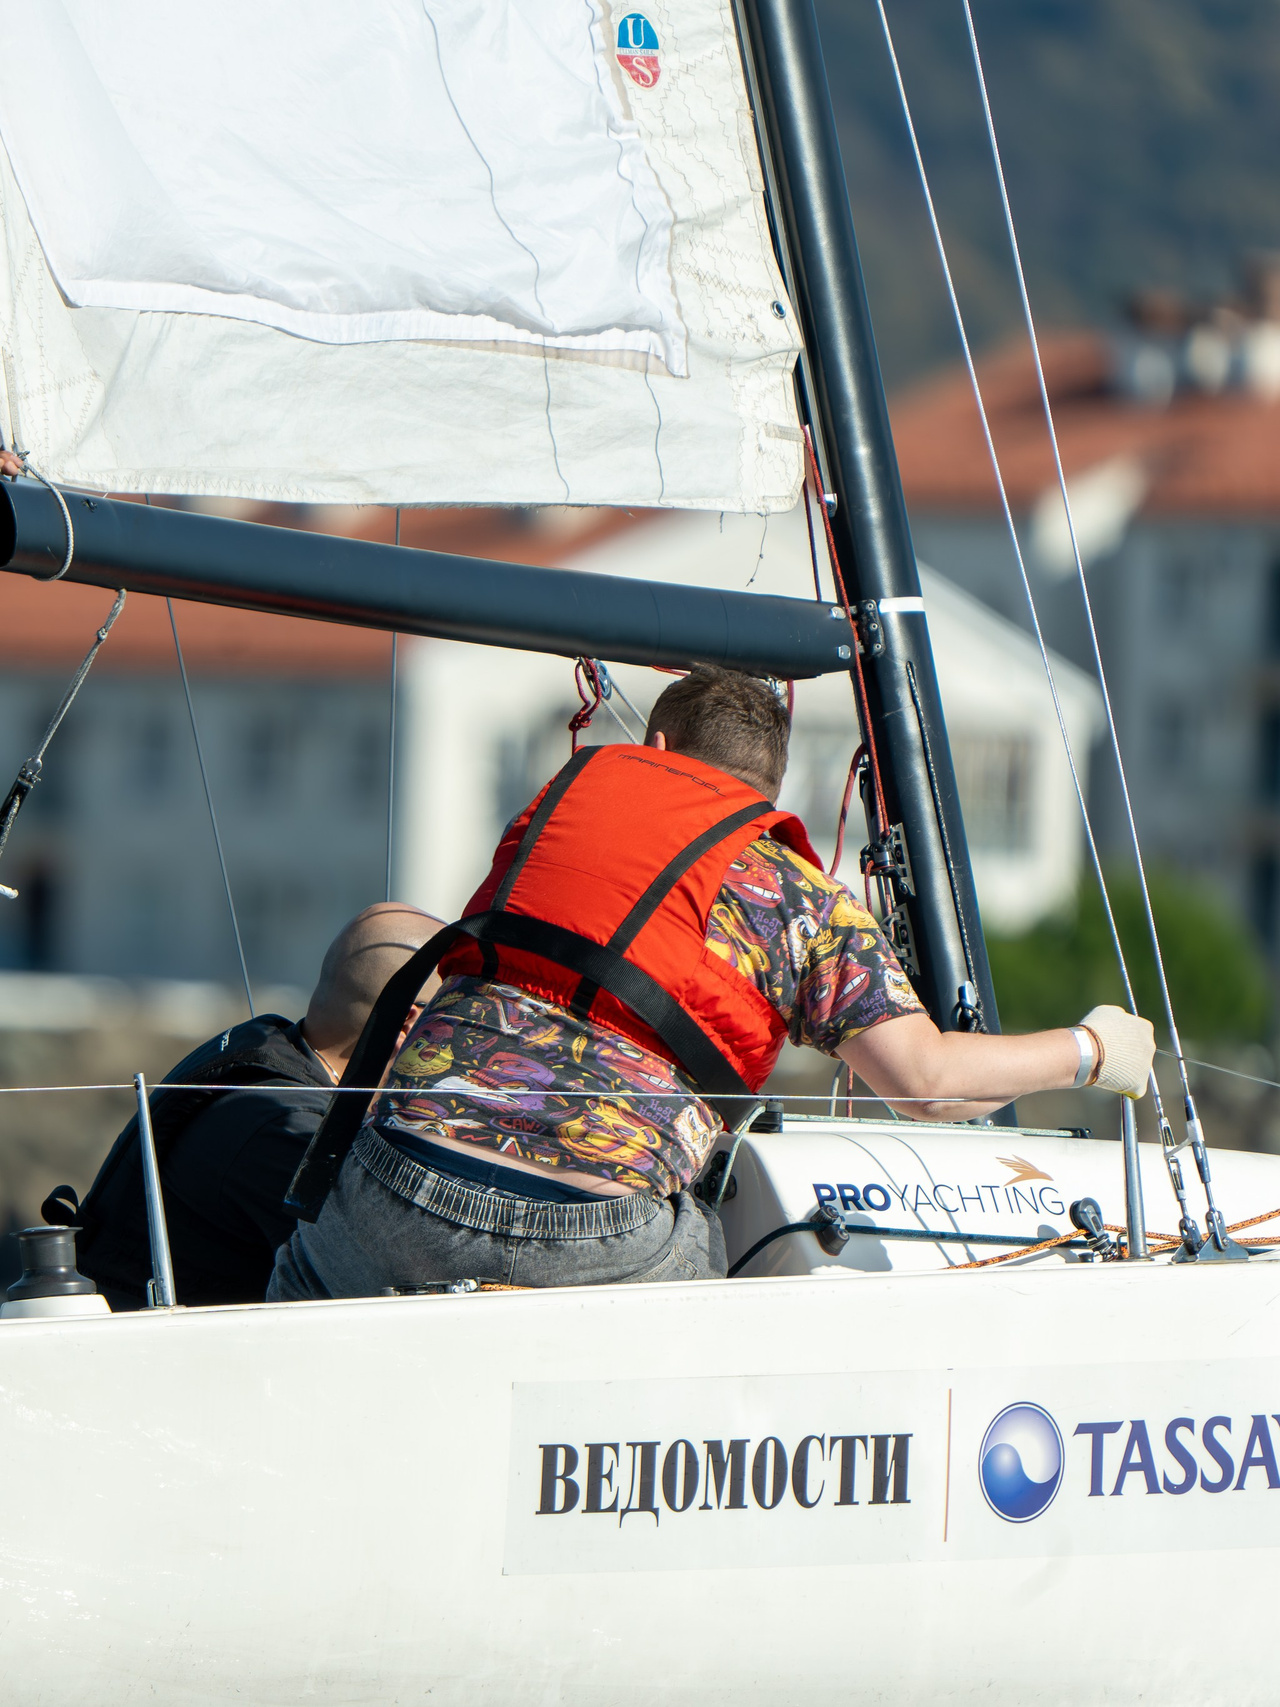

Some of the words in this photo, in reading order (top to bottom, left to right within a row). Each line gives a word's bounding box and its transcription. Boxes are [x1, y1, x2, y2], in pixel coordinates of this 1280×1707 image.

[625, 17, 646, 48] U
[812, 1183, 1066, 1216] PROYACHTING
[535, 1432, 914, 1528] ВЕДОМОСТИ
[1072, 1414, 1280, 1497] TASSA
